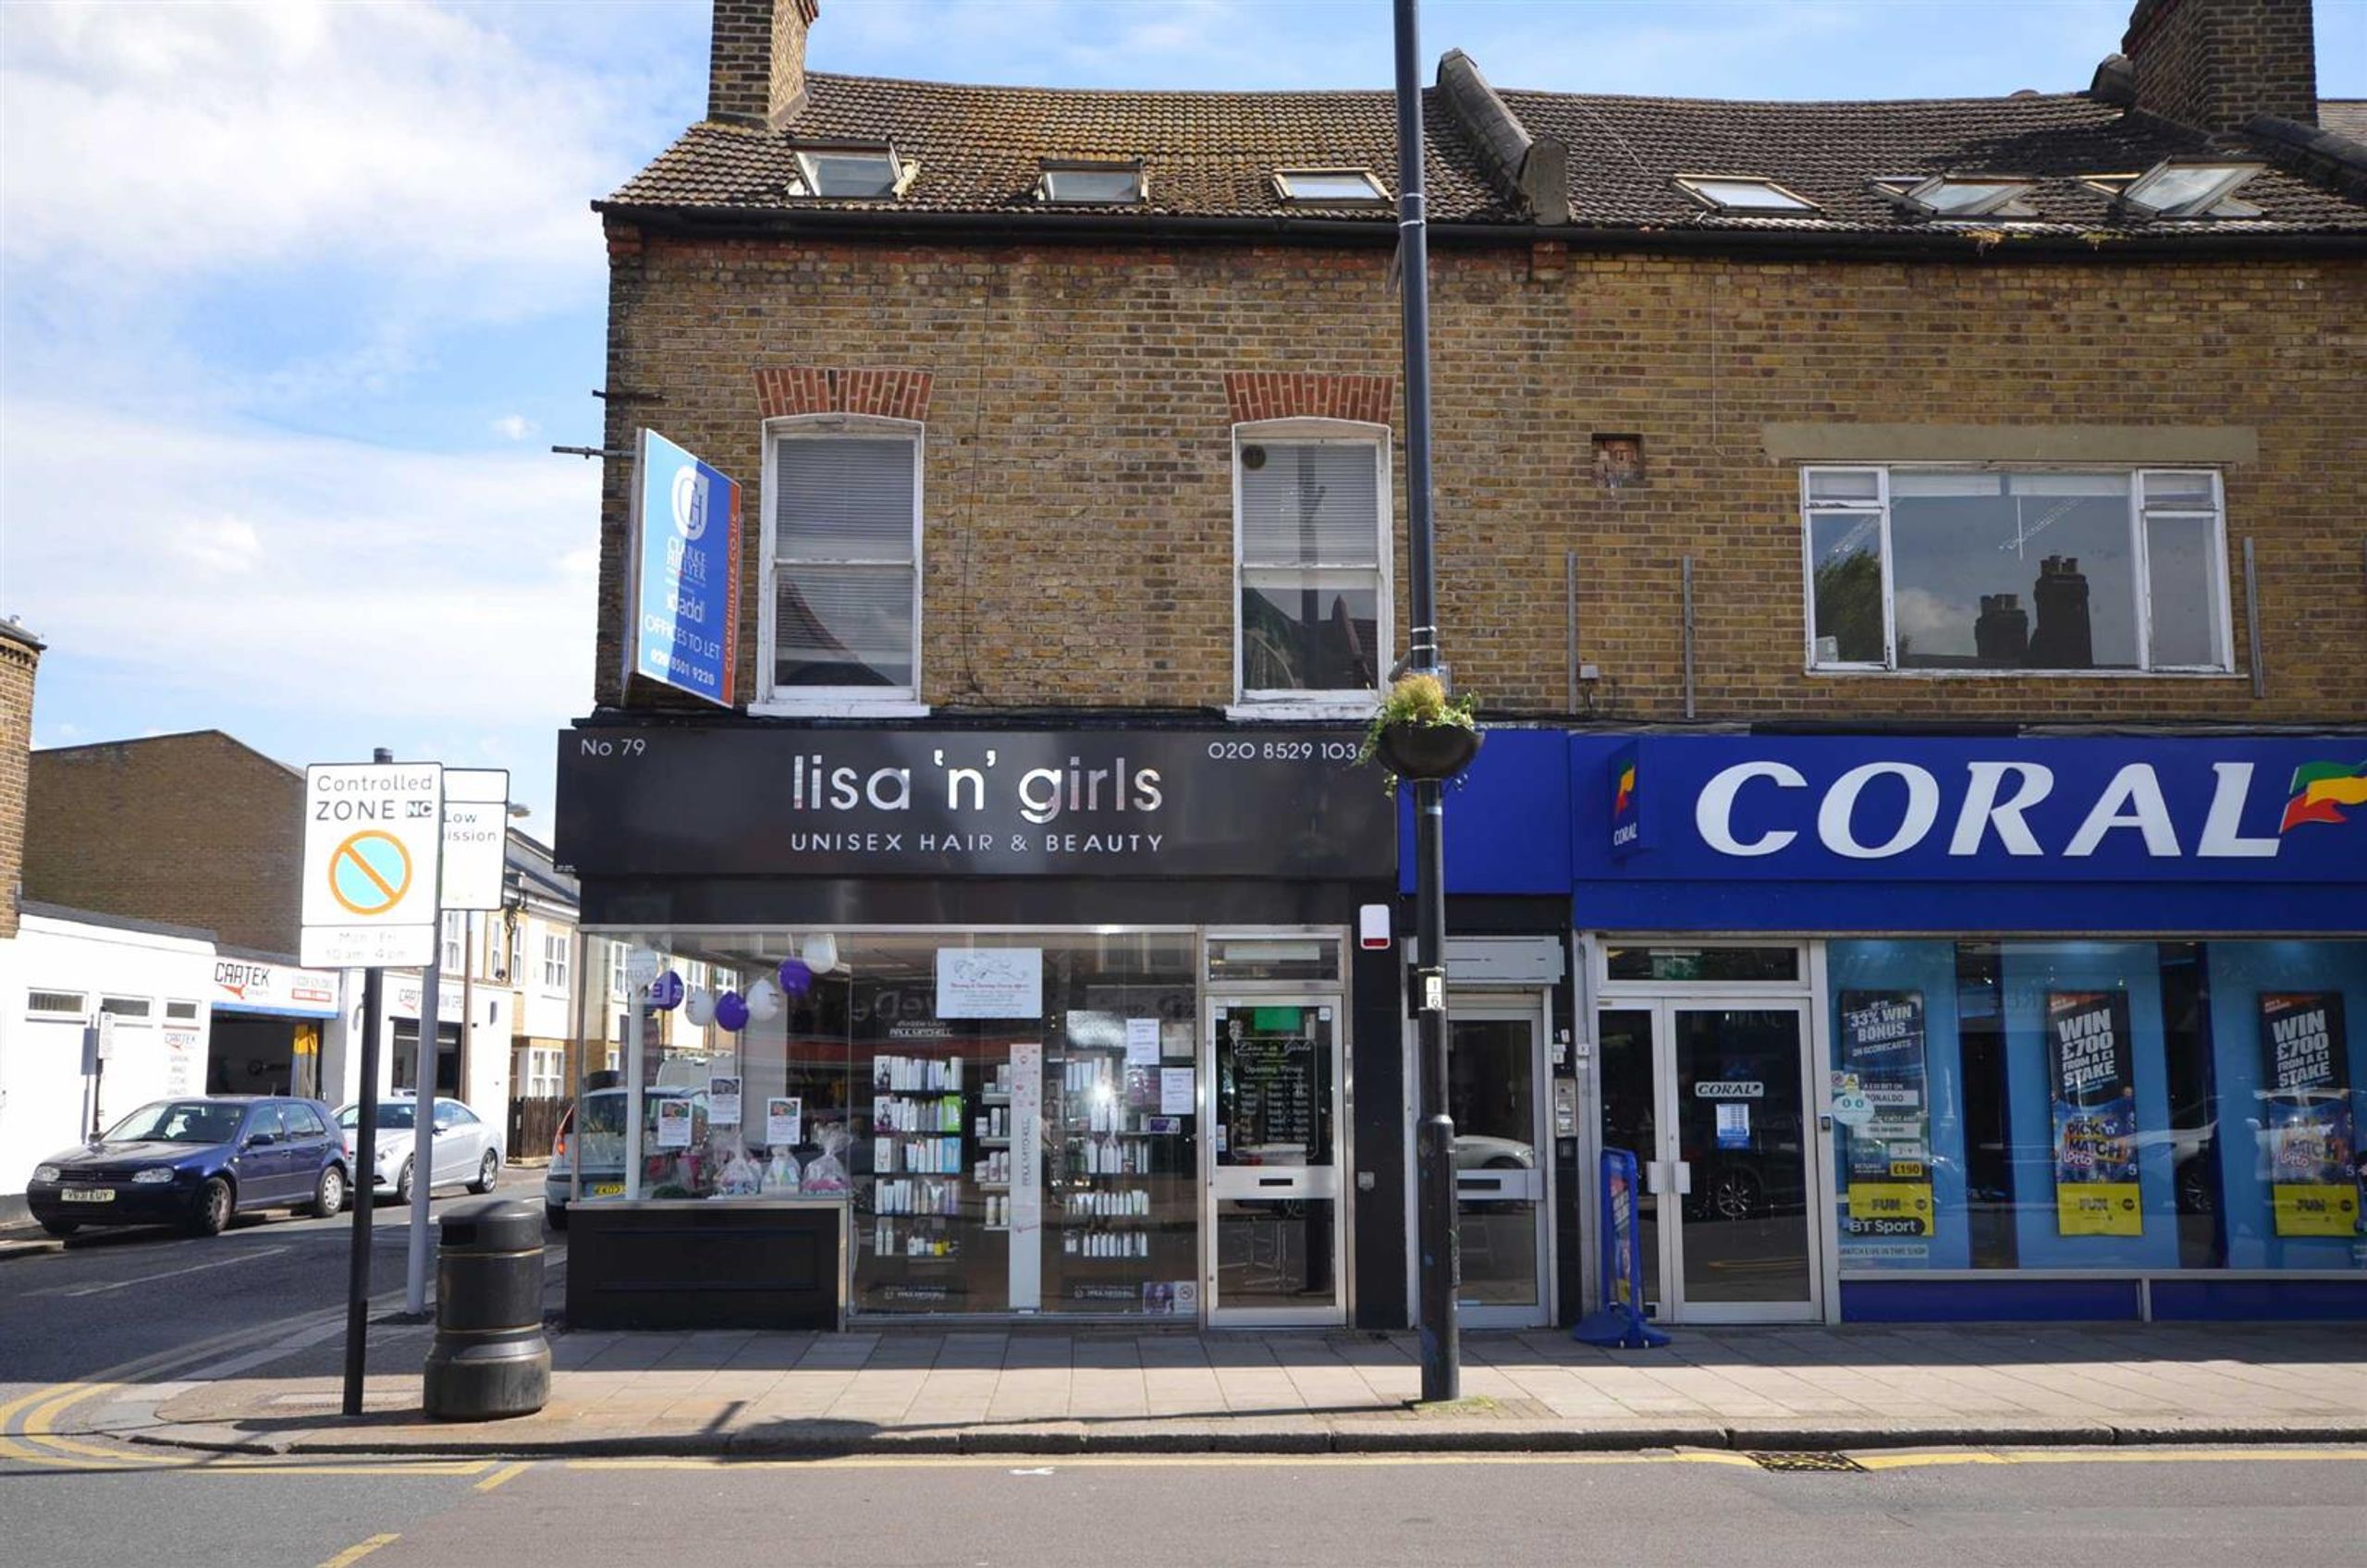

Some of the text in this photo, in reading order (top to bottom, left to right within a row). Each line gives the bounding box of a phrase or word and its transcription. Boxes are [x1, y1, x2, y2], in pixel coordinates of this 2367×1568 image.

[689, 633, 703, 652] TO
[705, 641, 720, 659] LET
[581, 739, 645, 756] No 79
[1208, 742, 1256, 759] 020
[1263, 742, 1312, 759] 8529
[317, 775, 432, 792] Controlled
[793, 754, 911, 810] lisa
[1018, 756, 1163, 824] girls
[315, 800, 396, 821] ZONE
[1695, 760, 2282, 858] CORAL
[441, 829, 497, 842] ission
[791, 834, 1163, 852] UNISEX HAIR & BEAUTY
[215, 962, 271, 987] CARTEK
[1850, 1005, 1912, 1027] 33% WIN
[2057, 1009, 2111, 1042] WIN
[2273, 1010, 2325, 1043] WIN
[1858, 1022, 1907, 1042] BONUS
[2062, 1031, 2114, 1060] £700
[2276, 1032, 2329, 1061] £700
[2063, 1049, 2114, 1072] FROM A £1
[2277, 1049, 2329, 1072] FROM A £1
[2064, 1060, 2116, 1086] STAKE
[2278, 1061, 2330, 1087] STAKE
[1698, 1084, 1753, 1095] CORAL
[1874, 1219, 1917, 1234] Sport
